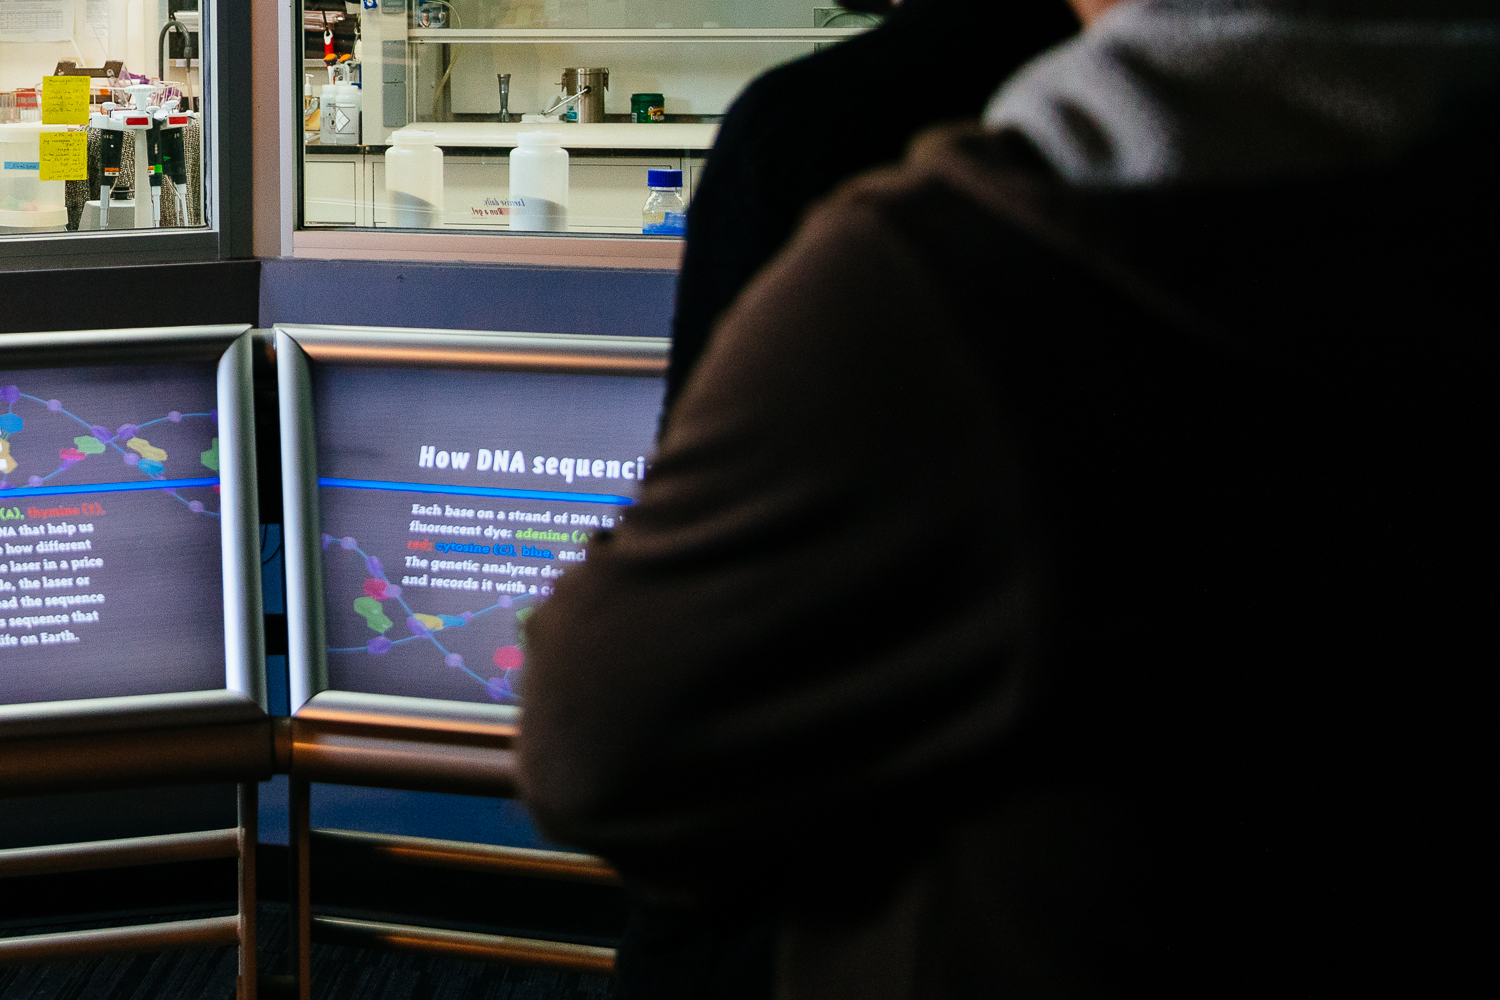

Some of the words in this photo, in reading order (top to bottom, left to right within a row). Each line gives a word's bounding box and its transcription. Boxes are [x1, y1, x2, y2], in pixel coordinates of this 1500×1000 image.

[419, 445, 470, 470] How
[477, 449, 526, 473] DNA
[532, 456, 646, 483] sequenci
[0, 507, 24, 520] (A),
[28, 506, 79, 519] thymine
[411, 504, 441, 516] Each
[444, 505, 475, 519] base
[477, 508, 494, 519] on
[497, 511, 505, 520] a
[508, 511, 551, 523] strand
[554, 511, 568, 524] of
[570, 514, 599, 527] DNA
[601, 515, 614, 527] is
[18, 524, 45, 536] that
[47, 522, 76, 536] help
[78, 523, 94, 533] us
[409, 520, 481, 537] fluorescent
[484, 525, 513, 539] dye:
[515, 528, 569, 542] adenine
[572, 530, 589, 543] (A
[5, 543, 33, 555] how
[36, 539, 91, 553] different
[436, 541, 491, 555] cytosine
[522, 546, 554, 560] blue,
[558, 549, 586, 562] and
[10, 560, 41, 572] laser
[43, 559, 57, 570] in
[60, 559, 68, 569] a
[71, 556, 103, 572] price
[405, 556, 428, 568] The
[431, 558, 479, 573] genetic
[482, 560, 538, 577] analyzer
[19, 578, 41, 590] the
[42, 576, 73, 588] laser
[76, 576, 90, 586] or
[402, 574, 428, 587] and
[431, 576, 479, 590] records
[482, 578, 492, 591] it
[496, 580, 526, 594] with
[528, 585, 537, 595] a
[20, 596, 42, 608] the
[45, 593, 105, 608] sequence
[9, 614, 69, 629] sequence
[71, 610, 99, 622] that
[20, 635, 38, 645] on
[40, 630, 80, 643] Earth.
